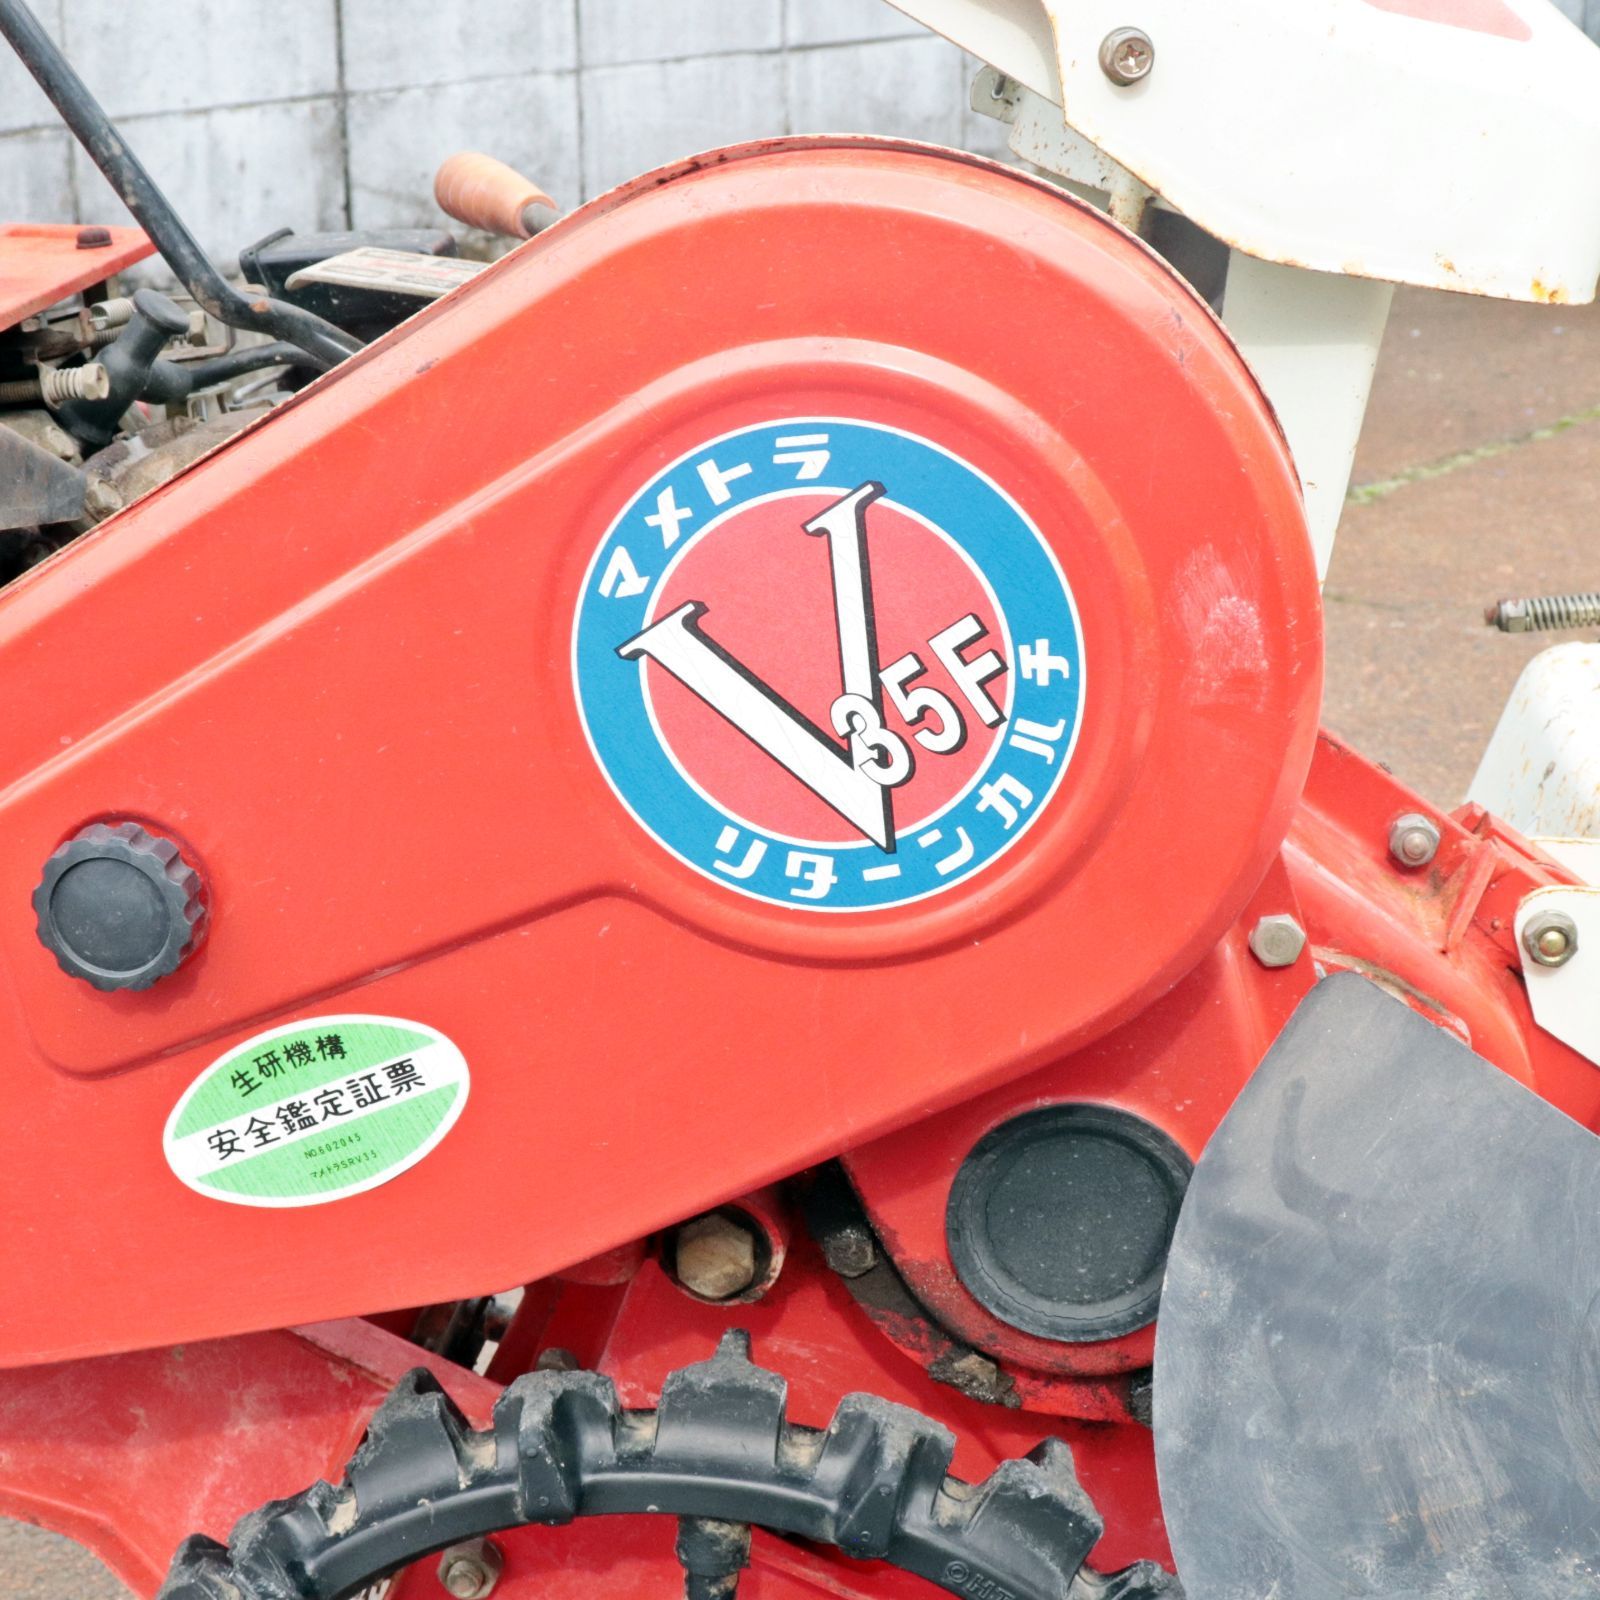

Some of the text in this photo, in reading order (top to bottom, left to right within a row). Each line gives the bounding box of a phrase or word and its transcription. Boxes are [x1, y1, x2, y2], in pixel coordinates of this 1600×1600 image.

[598, 433, 831, 599] マメトラ
[713, 638, 1070, 899] リターンカルチ
[829, 612, 1009, 787] 35F
[207, 1058, 426, 1161] 安全鑑定証票
[230, 1033, 348, 1097] 生研機構
